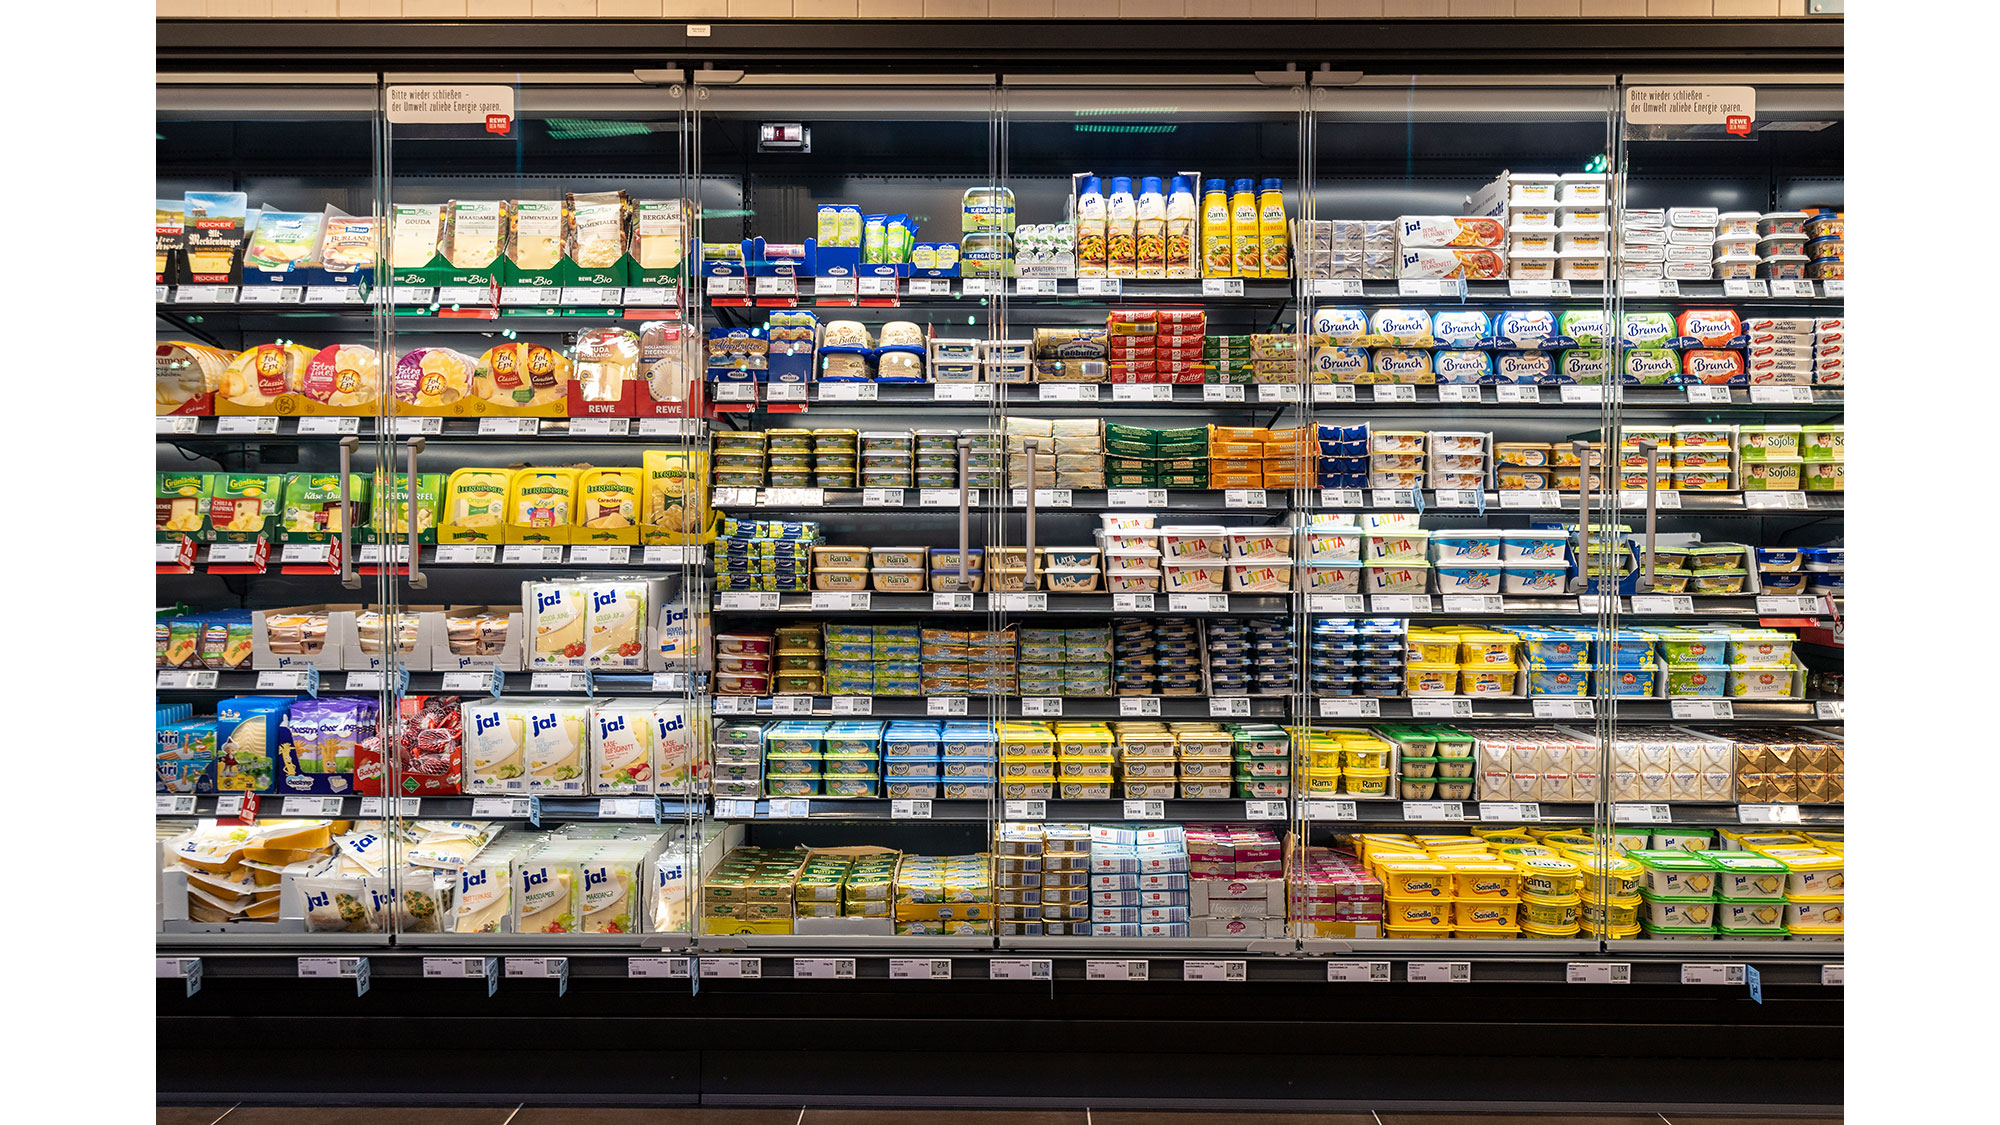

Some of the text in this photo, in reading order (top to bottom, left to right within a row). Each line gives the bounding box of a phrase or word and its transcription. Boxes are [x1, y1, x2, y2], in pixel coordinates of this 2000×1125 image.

[392, 90, 462, 100] Bitte wieder schließen
[1631, 90, 1703, 100] Bitte wieder schließen
[392, 102, 502, 114] der Umwelt zuliebe Energie sparen.
[1631, 102, 1743, 115] der Umwelt zuliebe Energie sparen.
[1085, 198, 1096, 207] ja!
[1113, 197, 1123, 207] ja!
[1405, 221, 1421, 236] ja!
[1404, 253, 1420, 267] ja!
[406, 274, 426, 284] Bio
[468, 274, 488, 284] Bio
[533, 276, 553, 286] Bio
[592, 274, 612, 284] Bio
[656, 275, 677, 285] Bio
[1320, 320, 1359, 332] Brunch
[1383, 320, 1423, 332] Brunch
[1442, 322, 1482, 334] Brunch
[1508, 320, 1548, 333] Brunch
[1628, 324, 1668, 336] Brunch
[1691, 320, 1731, 333] Brunch
[714, 340, 765, 351] Alpenbutter
[264, 352, 278, 362] Fol
[1321, 356, 1361, 370] Brunch
[262, 360, 279, 372] Epi
[312, 362, 335, 370] Extra
[1382, 357, 1423, 370] Brunch
[1443, 359, 1484, 371] Brunch
[1506, 359, 1545, 372] Brunch
[1632, 358, 1673, 371] Brunch
[1694, 358, 1735, 371] Brunch
[397, 366, 421, 375] Extra
[260, 379, 284, 388] Classic
[1179, 374, 1203, 382] Butter
[588, 404, 615, 413] REWE
[656, 404, 682, 414] REWE
[1768, 437, 1795, 448] Sojola
[1769, 468, 1796, 479] Sojola
[304, 492, 323, 500] Käse
[458, 485, 504, 496] LEERDAMMER
[522, 487, 569, 497] LEERDAMMER
[587, 485, 634, 495] LEERDAMMER
[1121, 537, 1144, 549] LÄTTA
[1172, 539, 1207, 557] LÄTTA
[1238, 537, 1274, 557] LÄTTA
[1312, 536, 1345, 555] LÄTTA
[1376, 539, 1412, 558] LÄTTA
[1456, 543, 1489, 558] Leicht
[1521, 543, 1553, 558] Leicht
[887, 555, 909, 563] Rama
[1122, 558, 1144, 570] LÄTTA
[830, 575, 852, 583] Rama
[887, 576, 909, 584] Rama
[1173, 569, 1208, 587] LÄTTA
[1240, 567, 1275, 587] LÄTTA
[1312, 570, 1345, 588] LÄTTA
[1377, 570, 1412, 588] LÄTTA
[1456, 573, 1489, 587] Leicht
[1522, 573, 1556, 588] Leicht
[1122, 578, 1145, 590] LÄTTA
[538, 591, 562, 614] ja!
[593, 589, 617, 614] ja!
[666, 608, 688, 626] ja!
[279, 657, 291, 668] ja!
[459, 657, 471, 669] ja!
[476, 712, 501, 736] ja!
[532, 713, 557, 738] ja!
[600, 716, 625, 740] ja!
[658, 715, 684, 740] ja!
[157, 730, 179, 744] kiri
[603, 741, 618, 749] KÄSE-
[605, 744, 634, 755] AUFSCHNITT
[158, 762, 178, 775] kiri
[1312, 779, 1333, 788] Rama
[1362, 780, 1383, 789] Rama
[350, 835, 378, 853] ja!
[462, 870, 487, 894] ja!
[523, 868, 548, 893] ja!
[584, 868, 608, 892] ja!
[1524, 876, 1552, 889] Rama
[1667, 875, 1678, 884] ja!
[1736, 876, 1746, 885] ja!
[1804, 874, 1815, 883] ja!
[1408, 882, 1433, 891] Sanella
[1476, 883, 1501, 892] Sanella
[1622, 880, 1640, 890] Ram
[305, 891, 330, 913] ja!
[463, 891, 493, 903] BUTTERKÄSE
[525, 891, 555, 902] MAASDAMER
[1406, 911, 1432, 919] Sanella
[1474, 912, 1499, 920] Sanella
[1734, 907, 1744, 916] ja!
[1800, 906, 1811, 915] ja!
